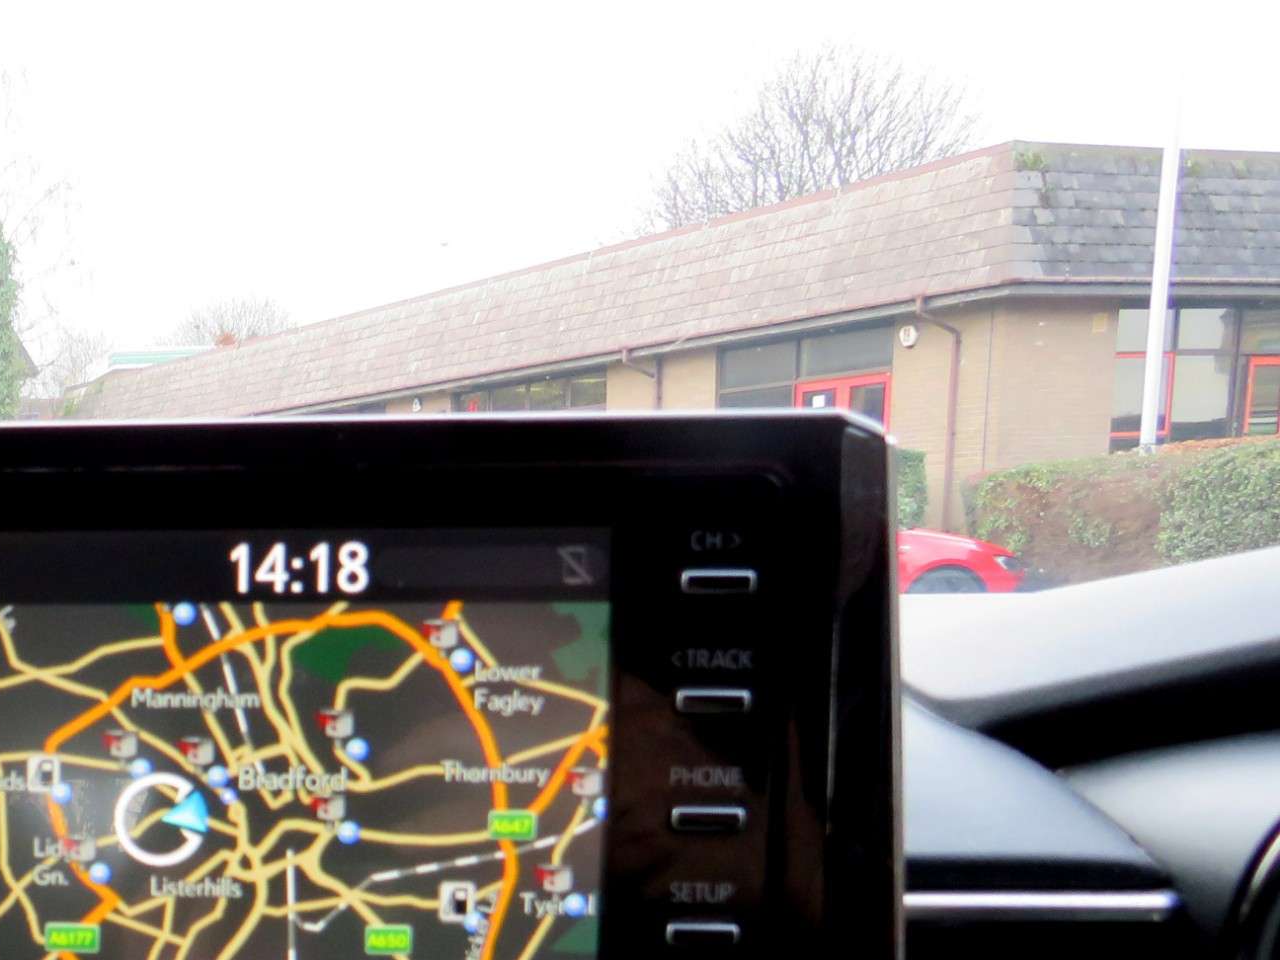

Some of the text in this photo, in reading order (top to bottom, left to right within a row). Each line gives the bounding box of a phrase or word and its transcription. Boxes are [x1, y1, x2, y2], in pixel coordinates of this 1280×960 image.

[229, 541, 370, 594] 14:18
[474, 661, 542, 681] Lower
[686, 649, 753, 669] TRACK
[131, 686, 261, 713] Manningham
[474, 691, 544, 716] Fagley
[238, 764, 349, 793] Bradford
[443, 761, 550, 788] Thornbury
[670, 766, 743, 787] PHONE
[150, 876, 243, 899] Listerhills
[671, 882, 735, 903] SETUP
